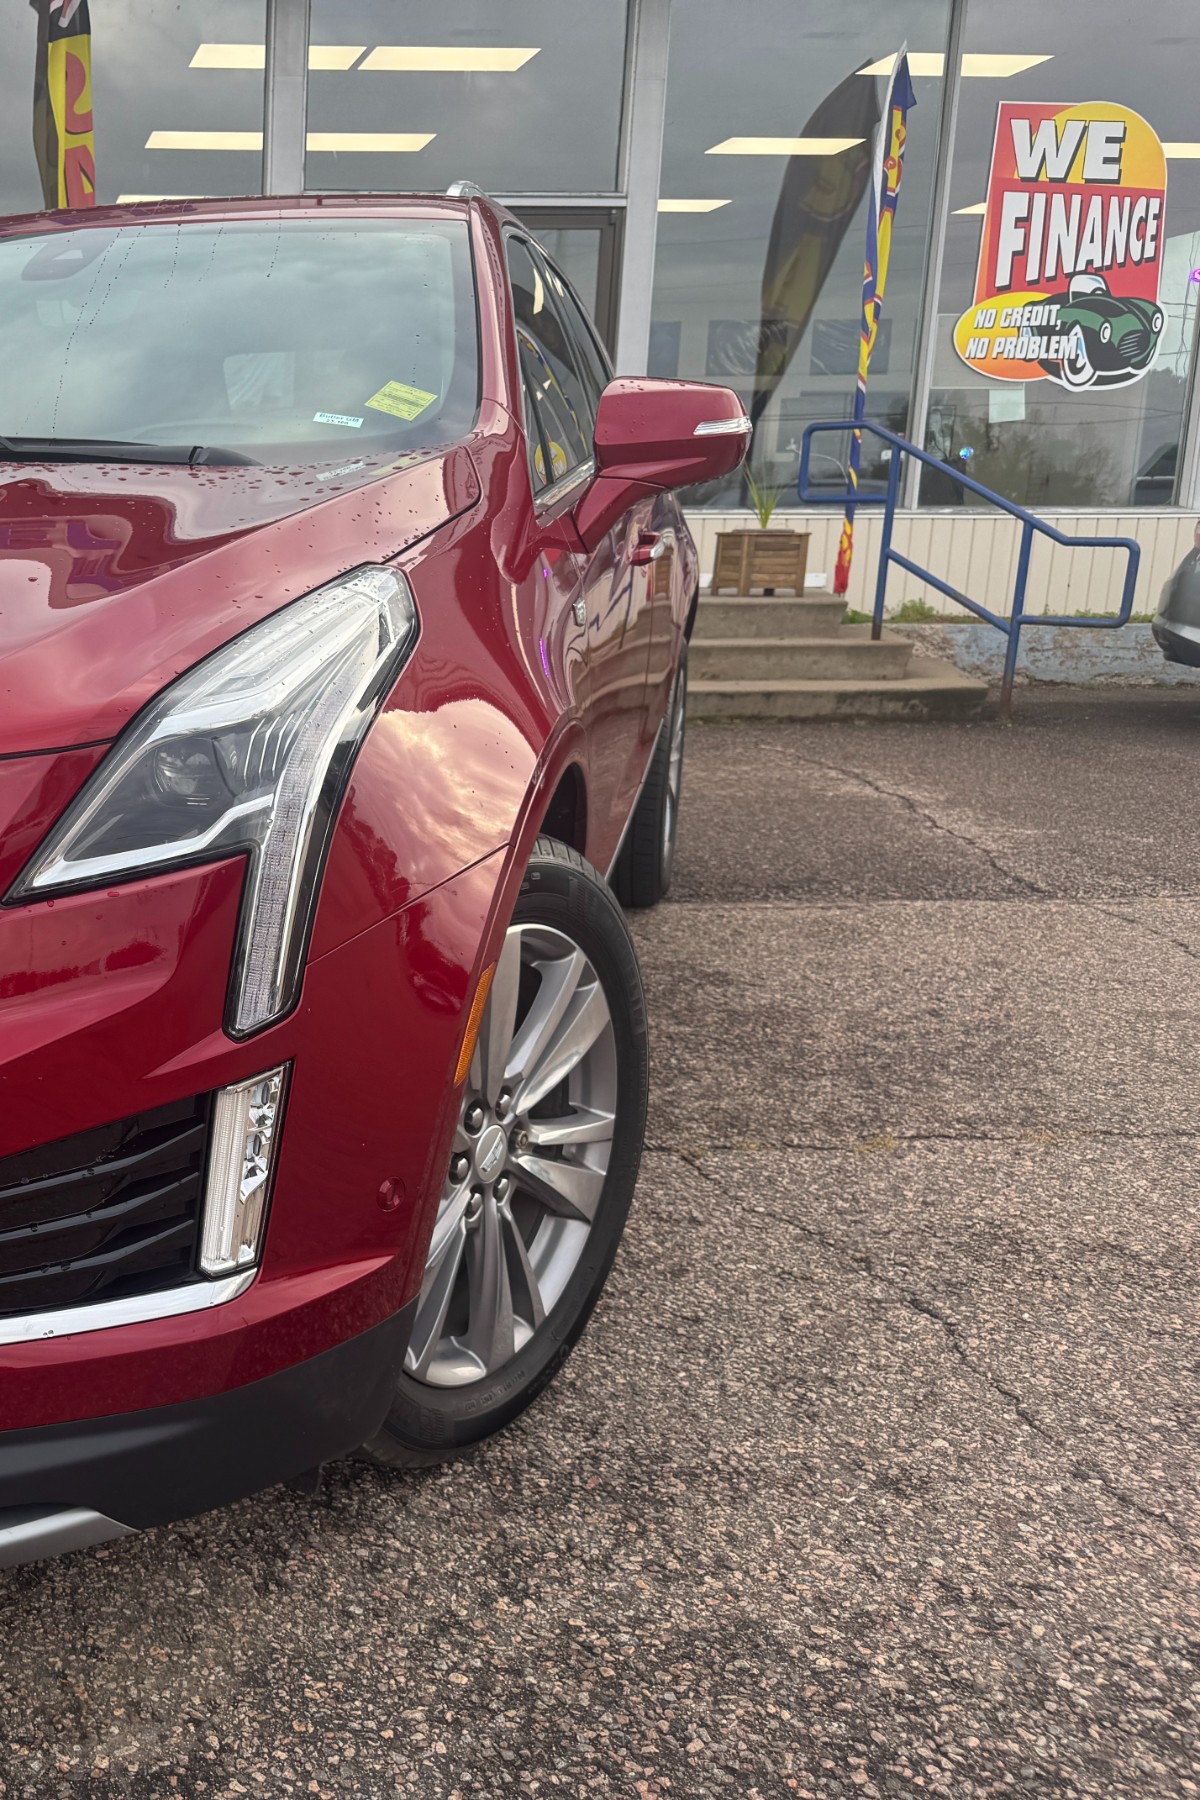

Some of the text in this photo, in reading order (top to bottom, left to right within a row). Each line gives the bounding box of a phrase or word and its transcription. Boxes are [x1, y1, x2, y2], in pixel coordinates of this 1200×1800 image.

[1010, 118, 1127, 184] WE
[995, 191, 1161, 291] FINANCE
[974, 304, 1061, 330] NO CREDIT,
[965, 335, 1079, 360] NO PROBLEM
